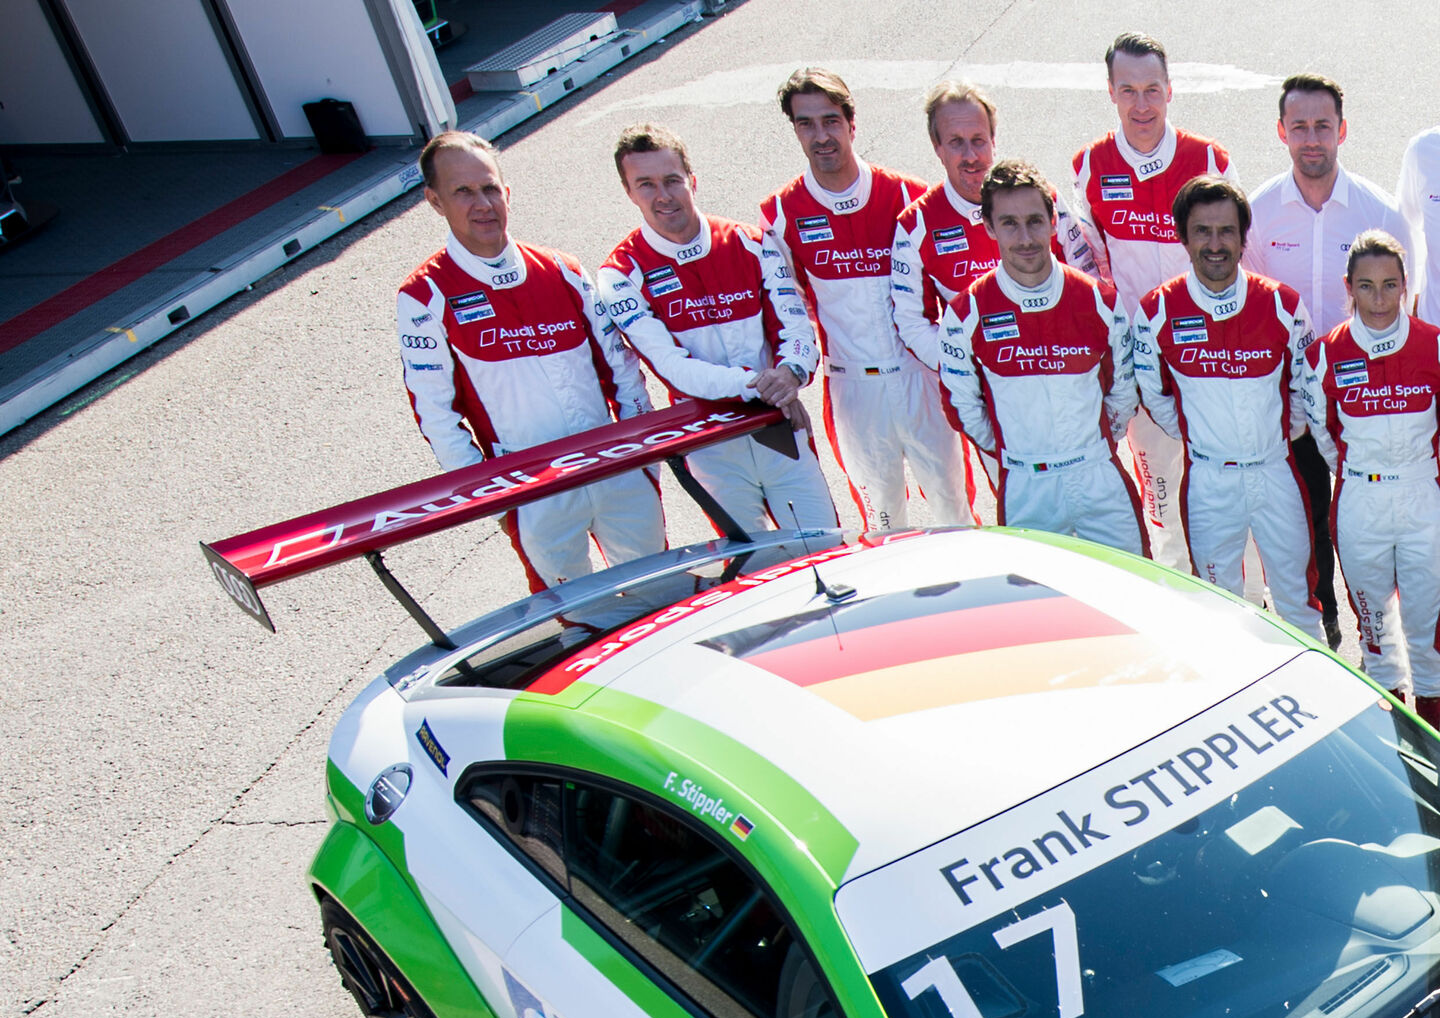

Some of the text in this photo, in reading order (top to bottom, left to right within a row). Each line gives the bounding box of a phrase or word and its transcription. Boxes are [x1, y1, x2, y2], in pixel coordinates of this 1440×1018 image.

[1129, 211, 1159, 223] Audi
[1130, 224, 1174, 240] TT Cup
[832, 248, 890, 261] Audi Spo
[834, 262, 880, 273] TT Cup
[685, 290, 754, 309] Audi Sport
[688, 308, 732, 321] TT Cup
[500, 320, 576, 340] Audi Sport
[504, 338, 556, 352] TT Cup
[1015, 345, 1090, 358] Audi Sport
[1199, 349, 1272, 362] Audi Sport
[1017, 359, 1065, 371] TT Cup
[1200, 362, 1247, 375] TT Cup
[1362, 384, 1431, 398] Audi Sport
[1362, 399, 1407, 411] TT Cup
[370, 411, 748, 533] Audi Sport
[1139, 451, 1156, 517] Audi Sport
[1157, 477, 1168, 518] TT Cup
[1356, 590, 1371, 623] Sport
[1375, 611, 1384, 631] Cup
[565, 590, 734, 674] Sport
[663, 771, 734, 825] F. Stippler
[939, 694, 1319, 906] Frank STIPPLER
